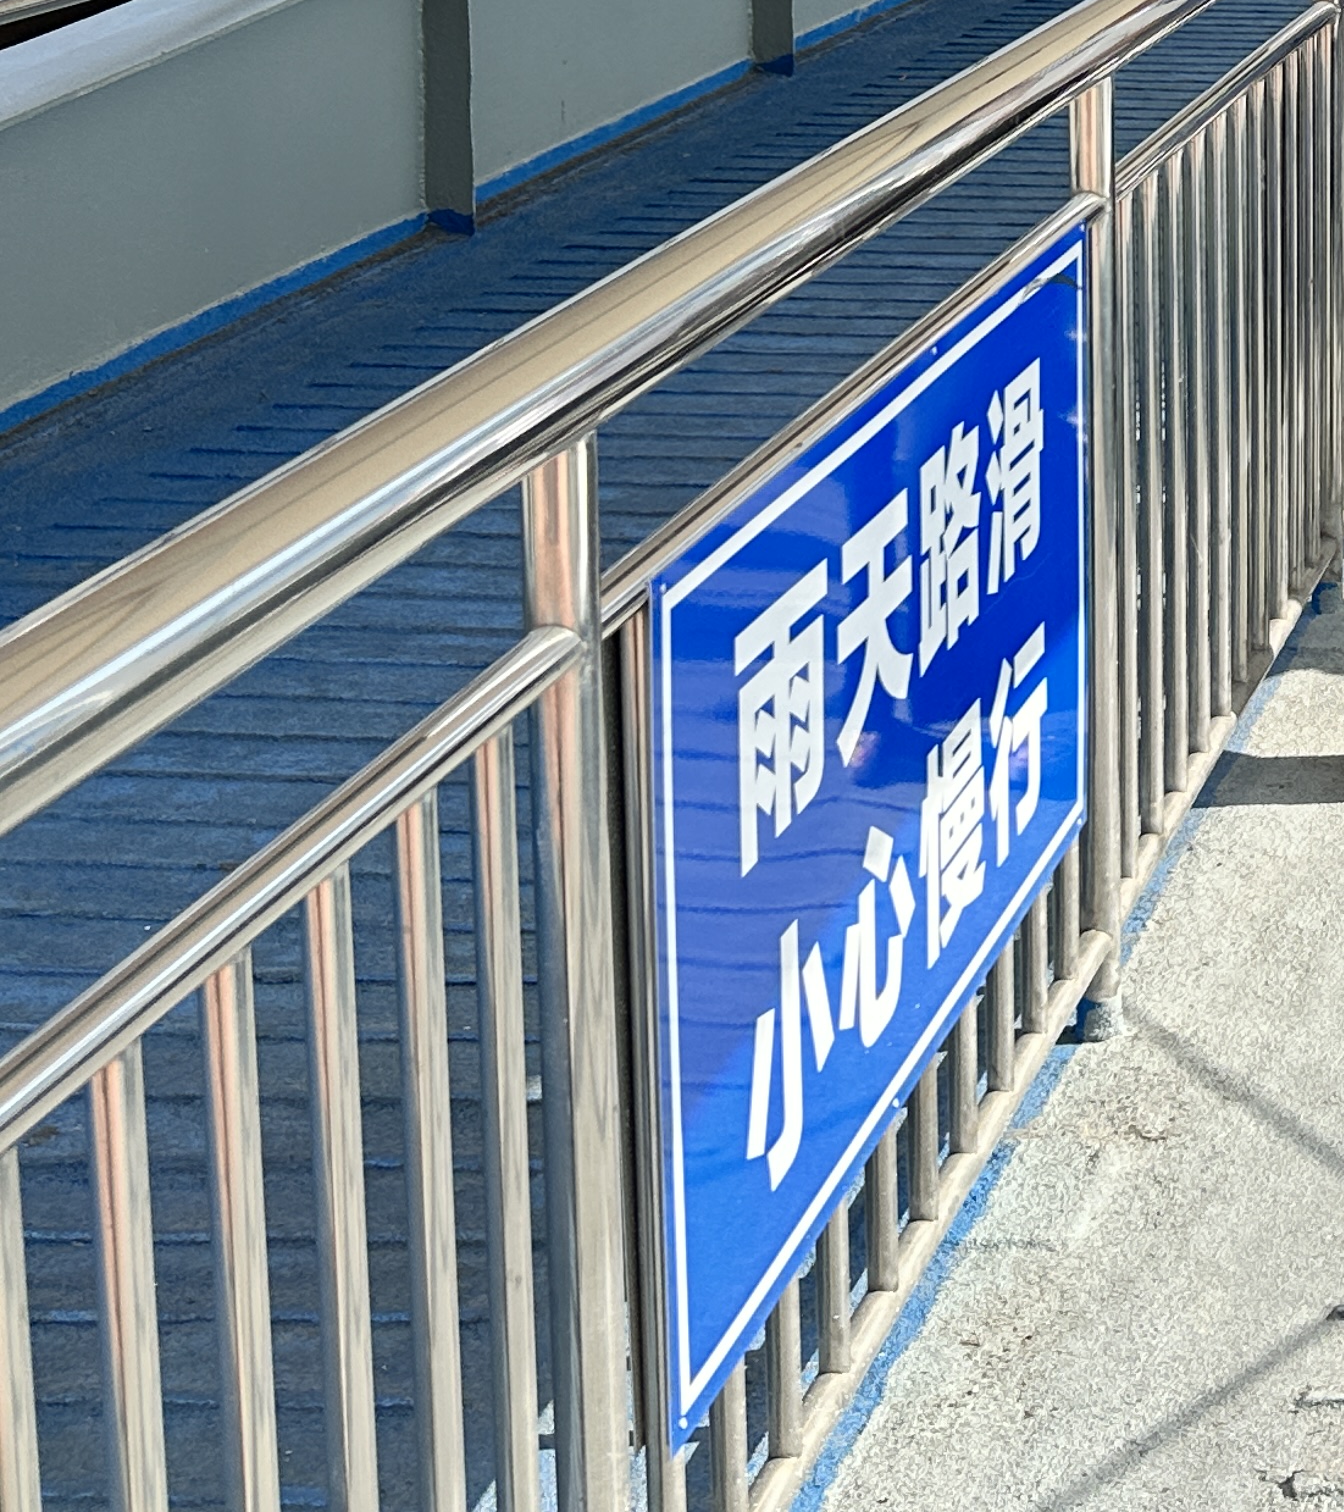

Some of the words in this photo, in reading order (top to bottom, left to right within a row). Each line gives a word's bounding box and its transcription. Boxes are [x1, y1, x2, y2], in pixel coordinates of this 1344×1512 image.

[734, 358, 1044, 878] 雨天路滑
[746, 622, 1048, 1192] 小心慢行
